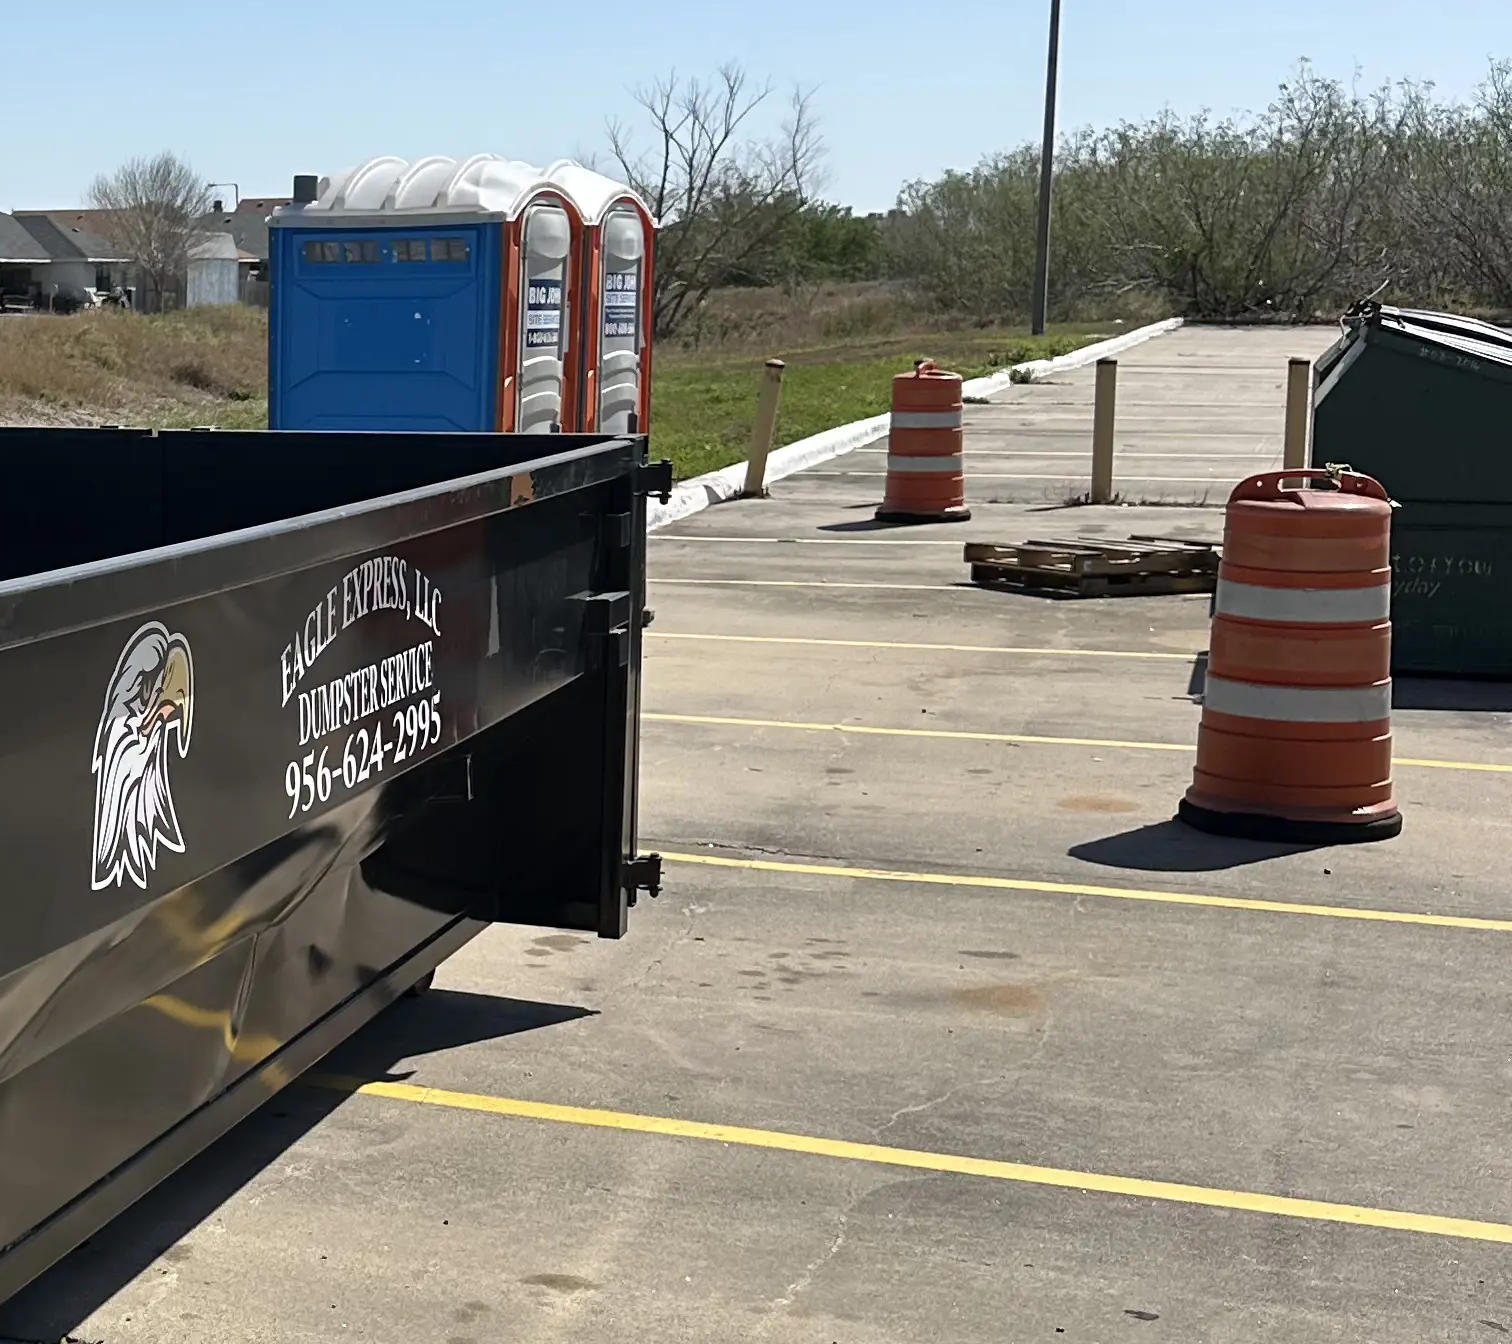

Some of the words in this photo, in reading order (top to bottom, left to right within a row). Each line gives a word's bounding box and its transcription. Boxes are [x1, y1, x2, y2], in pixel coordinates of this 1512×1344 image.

[529, 286, 546, 304] BIG
[606, 275, 623, 290] BIG
[280, 585, 338, 708] EAGLE
[341, 556, 412, 630] EXPRESS,
[414, 568, 442, 637] LLC
[298, 664, 380, 746] DUMPSTER
[380, 640, 434, 708] SERVICE
[285, 690, 442, 820] 956-624-2995
